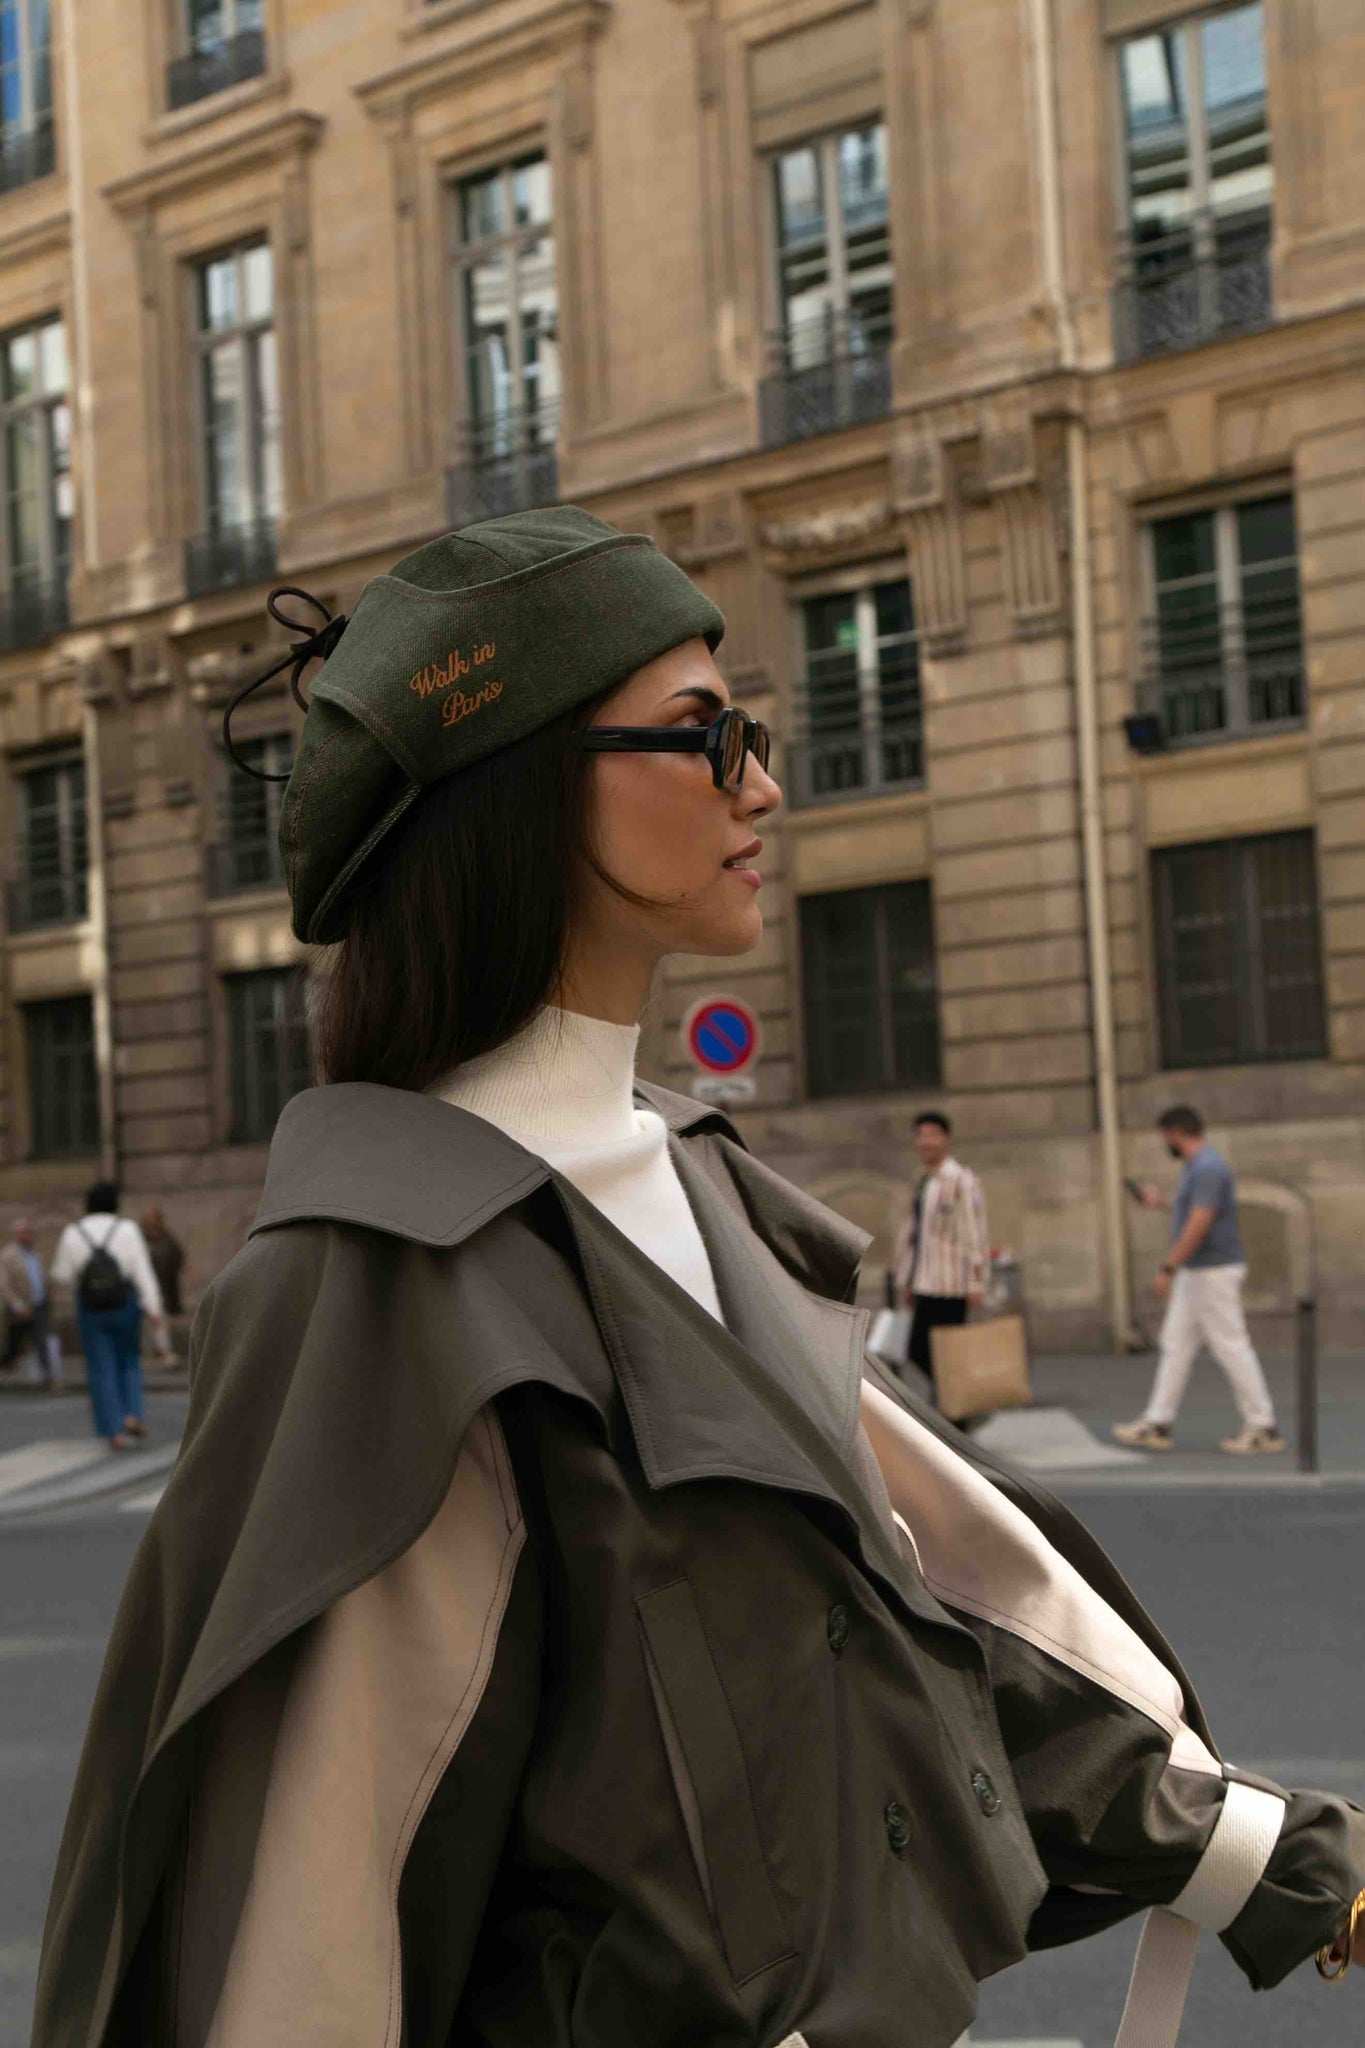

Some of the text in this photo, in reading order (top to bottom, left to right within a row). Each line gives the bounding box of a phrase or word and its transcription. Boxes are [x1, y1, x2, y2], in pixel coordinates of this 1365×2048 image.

[409, 641, 497, 699] Walk in
[442, 681, 503, 727] Paris
